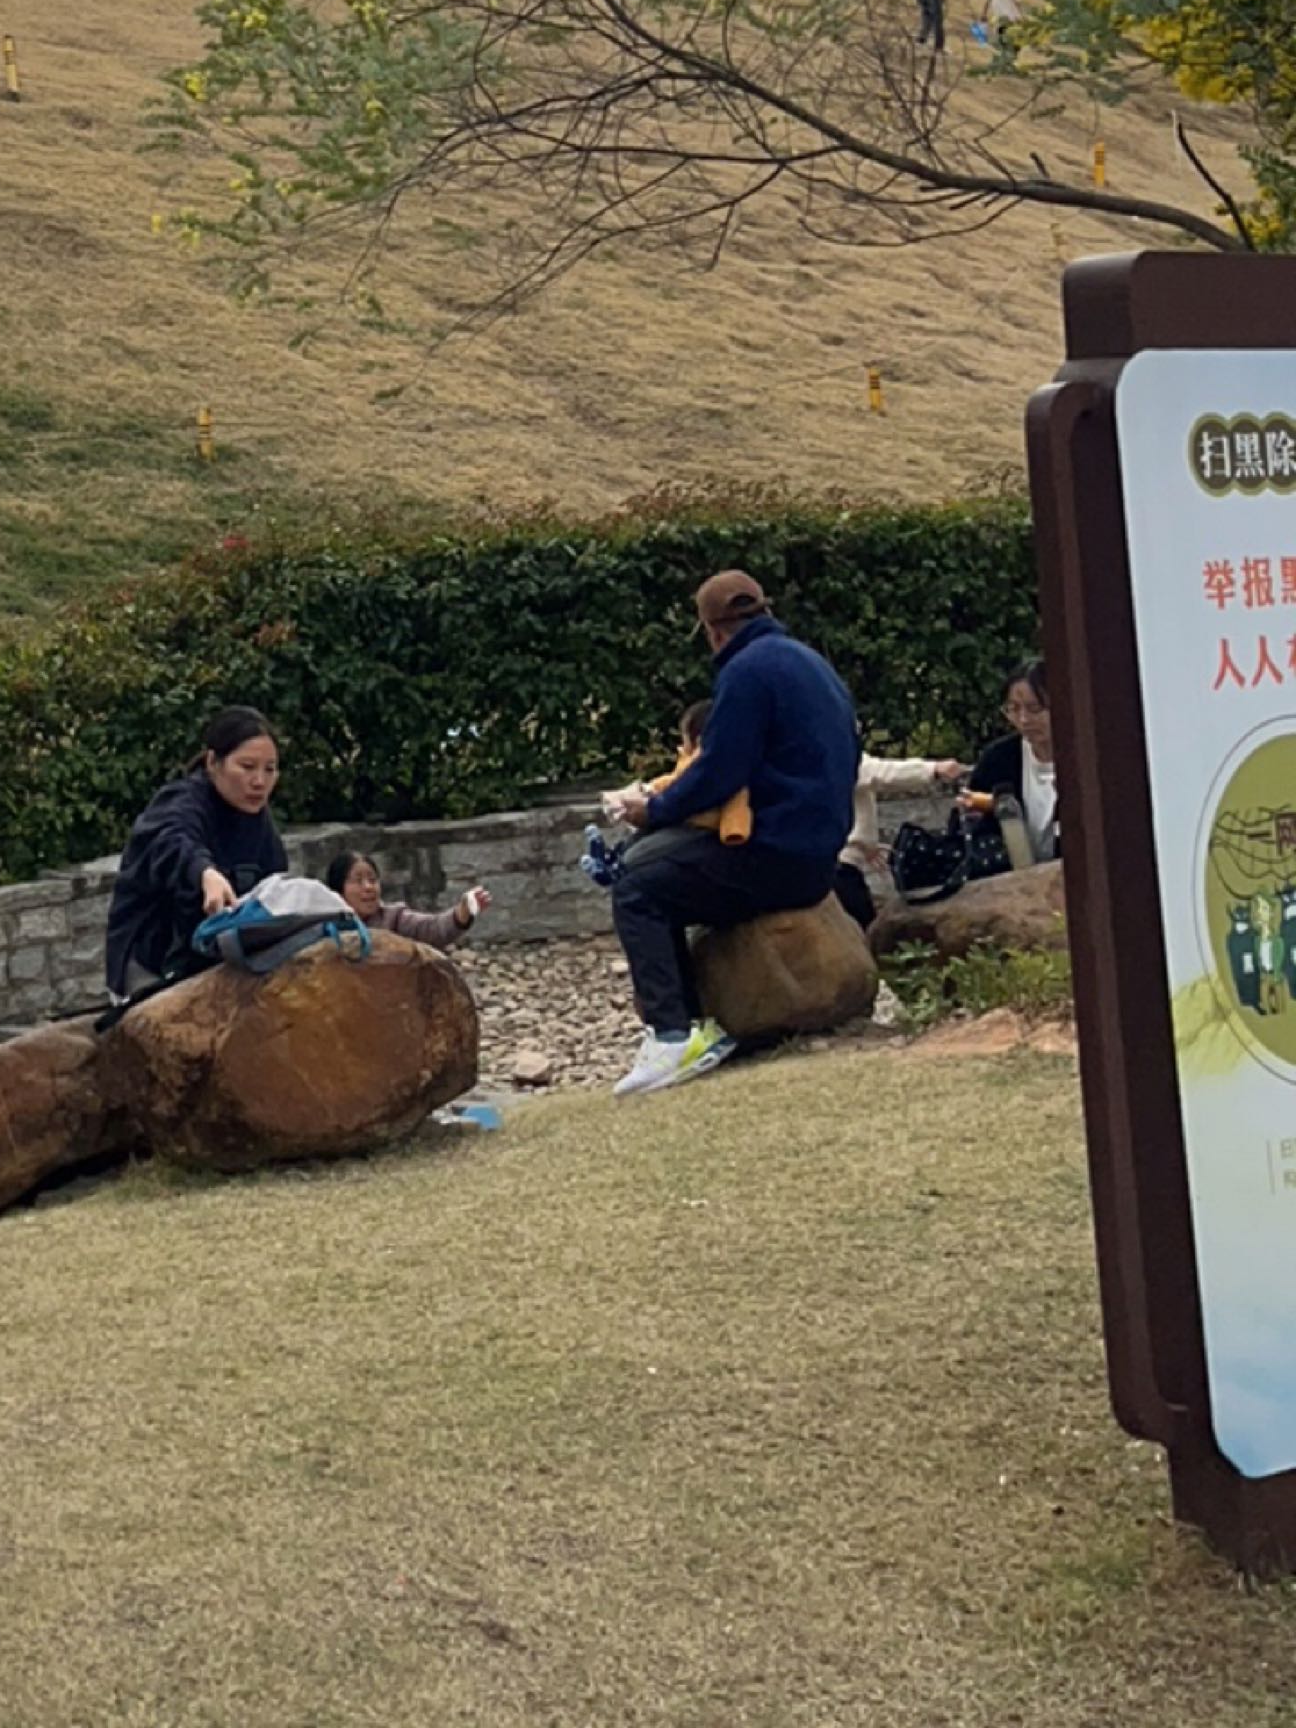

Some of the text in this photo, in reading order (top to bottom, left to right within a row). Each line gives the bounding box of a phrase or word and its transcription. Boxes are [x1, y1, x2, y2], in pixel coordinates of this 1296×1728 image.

[1200, 430, 1296, 478] 扫黑除
[1214, 633, 1296, 690] 人人
